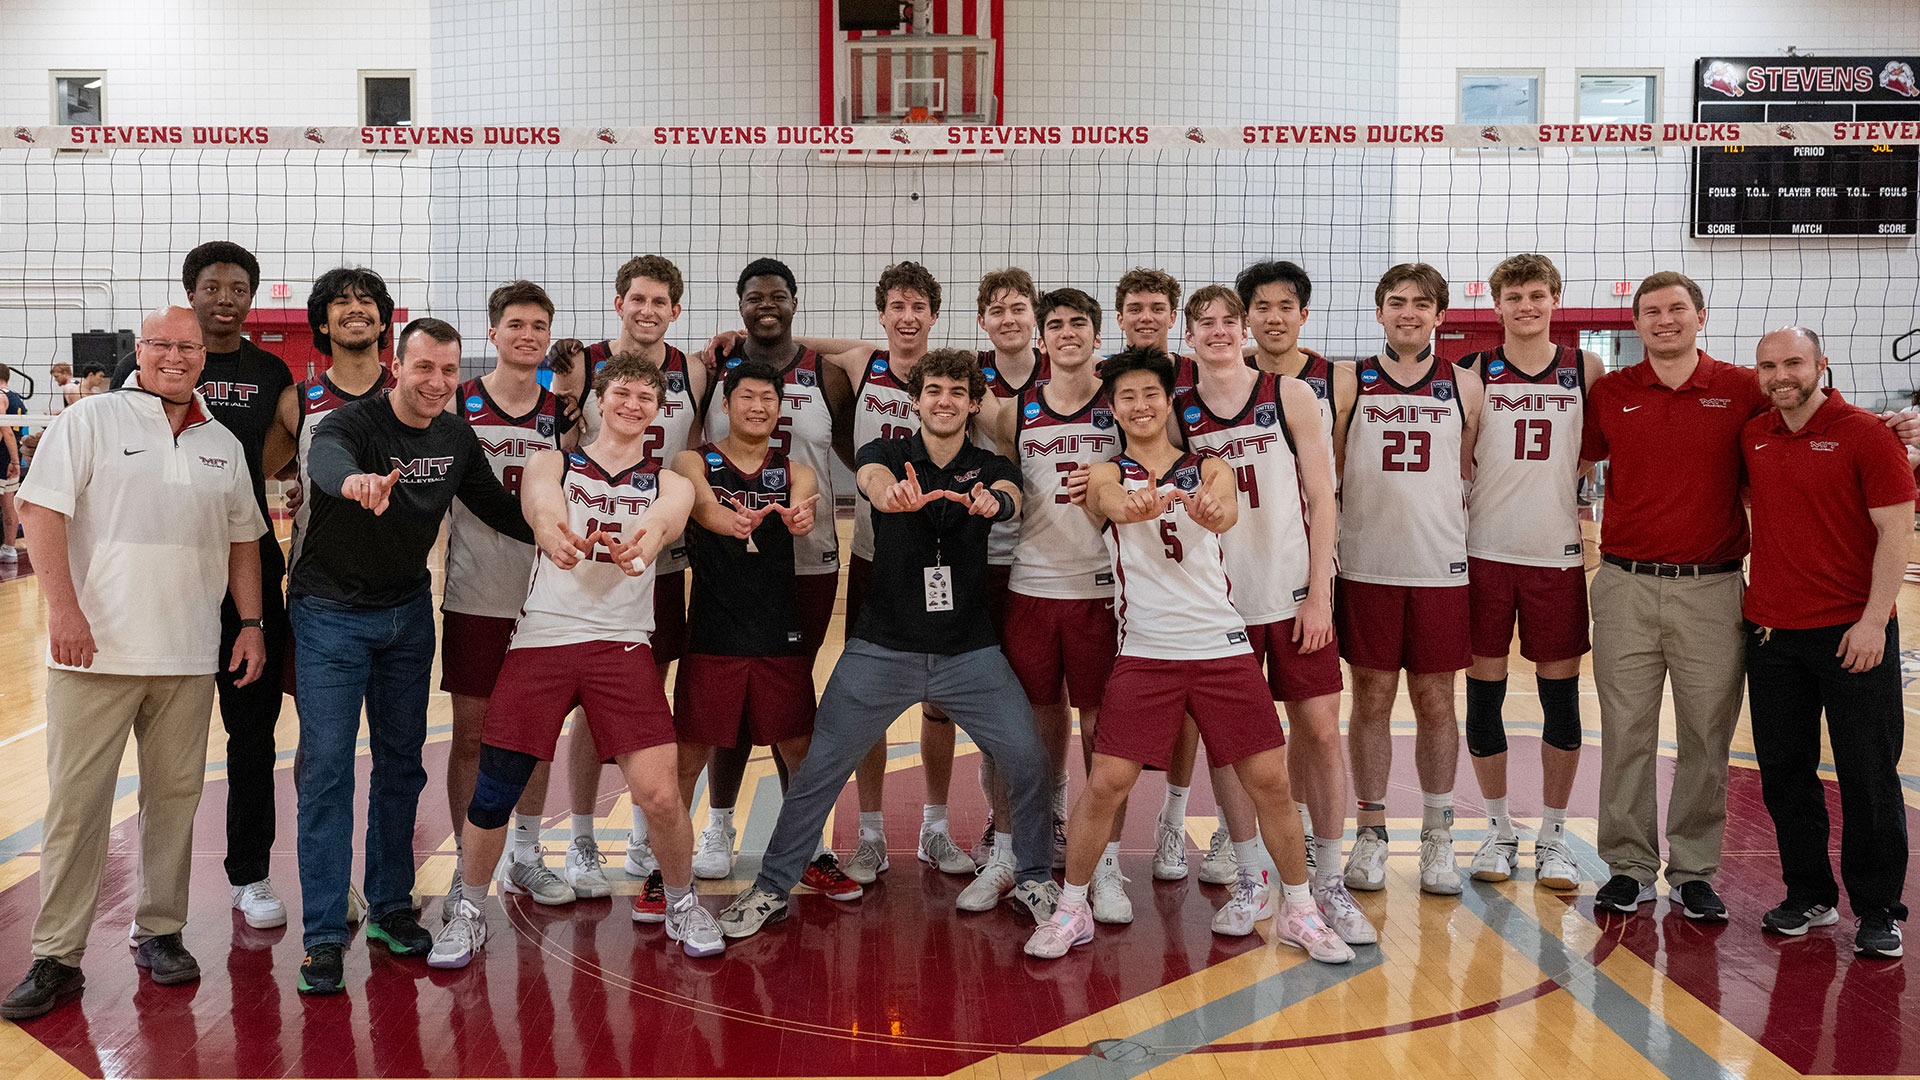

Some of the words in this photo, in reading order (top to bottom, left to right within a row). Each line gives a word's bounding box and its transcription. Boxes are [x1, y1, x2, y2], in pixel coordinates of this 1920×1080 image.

[1746, 66, 1873, 92] STEVENS
[71, 126, 182, 144] STEVENS
[193, 126, 269, 144] DUCKS
[361, 126, 474, 145] STEVENS
[484, 126, 560, 145] DUCKS
[654, 126, 767, 145] STEVENS
[777, 126, 854, 145] DUCKS
[947, 126, 1061, 144] STEVENS
[1072, 126, 1149, 144] DUCKS
[1243, 125, 1357, 143] STEVENS
[1367, 125, 1444, 143] DUCKS
[1538, 124, 1653, 142] STEVENS
[1662, 123, 1740, 142] DUCKS
[1793, 147, 1825, 157] PERIOD
[1708, 187, 1737, 197] FOULS
[1746, 187, 1770, 197] T.O.L.
[1778, 187, 1811, 197] PLAYER
[1816, 187, 1838, 197] FOUL
[1846, 187, 1870, 197] T.O.L.
[1879, 187, 1907, 197] FOULS
[1707, 224, 1735, 234] SCORE
[1792, 224, 1822, 234] MATCH
[1878, 224, 1907, 234] SCORE
[272, 284, 288, 296] EXIT
[1468, 282, 1485, 295] EXIT
[1615, 282, 1632, 294] EXIT
[864, 394, 914, 420] MI
[1256, 404, 1275, 412] UNITED
[1489, 394, 1577, 412] MIT
[1363, 405, 1451, 423] MIT
[1023, 434, 1115, 458] MIT
[1196, 433, 1277, 460] MIT
[1514, 419, 1552, 461] 13
[1382, 430, 1431, 472] 23
[390, 456, 454, 478] MIT
[1175, 467, 1196, 478] UNITED
[569, 483, 650, 516] MIT
[710, 486, 787, 509] MIT
[1160, 519, 1183, 563] 5
[1027, 892, 1041, 907] N
[755, 902, 771, 917] N
